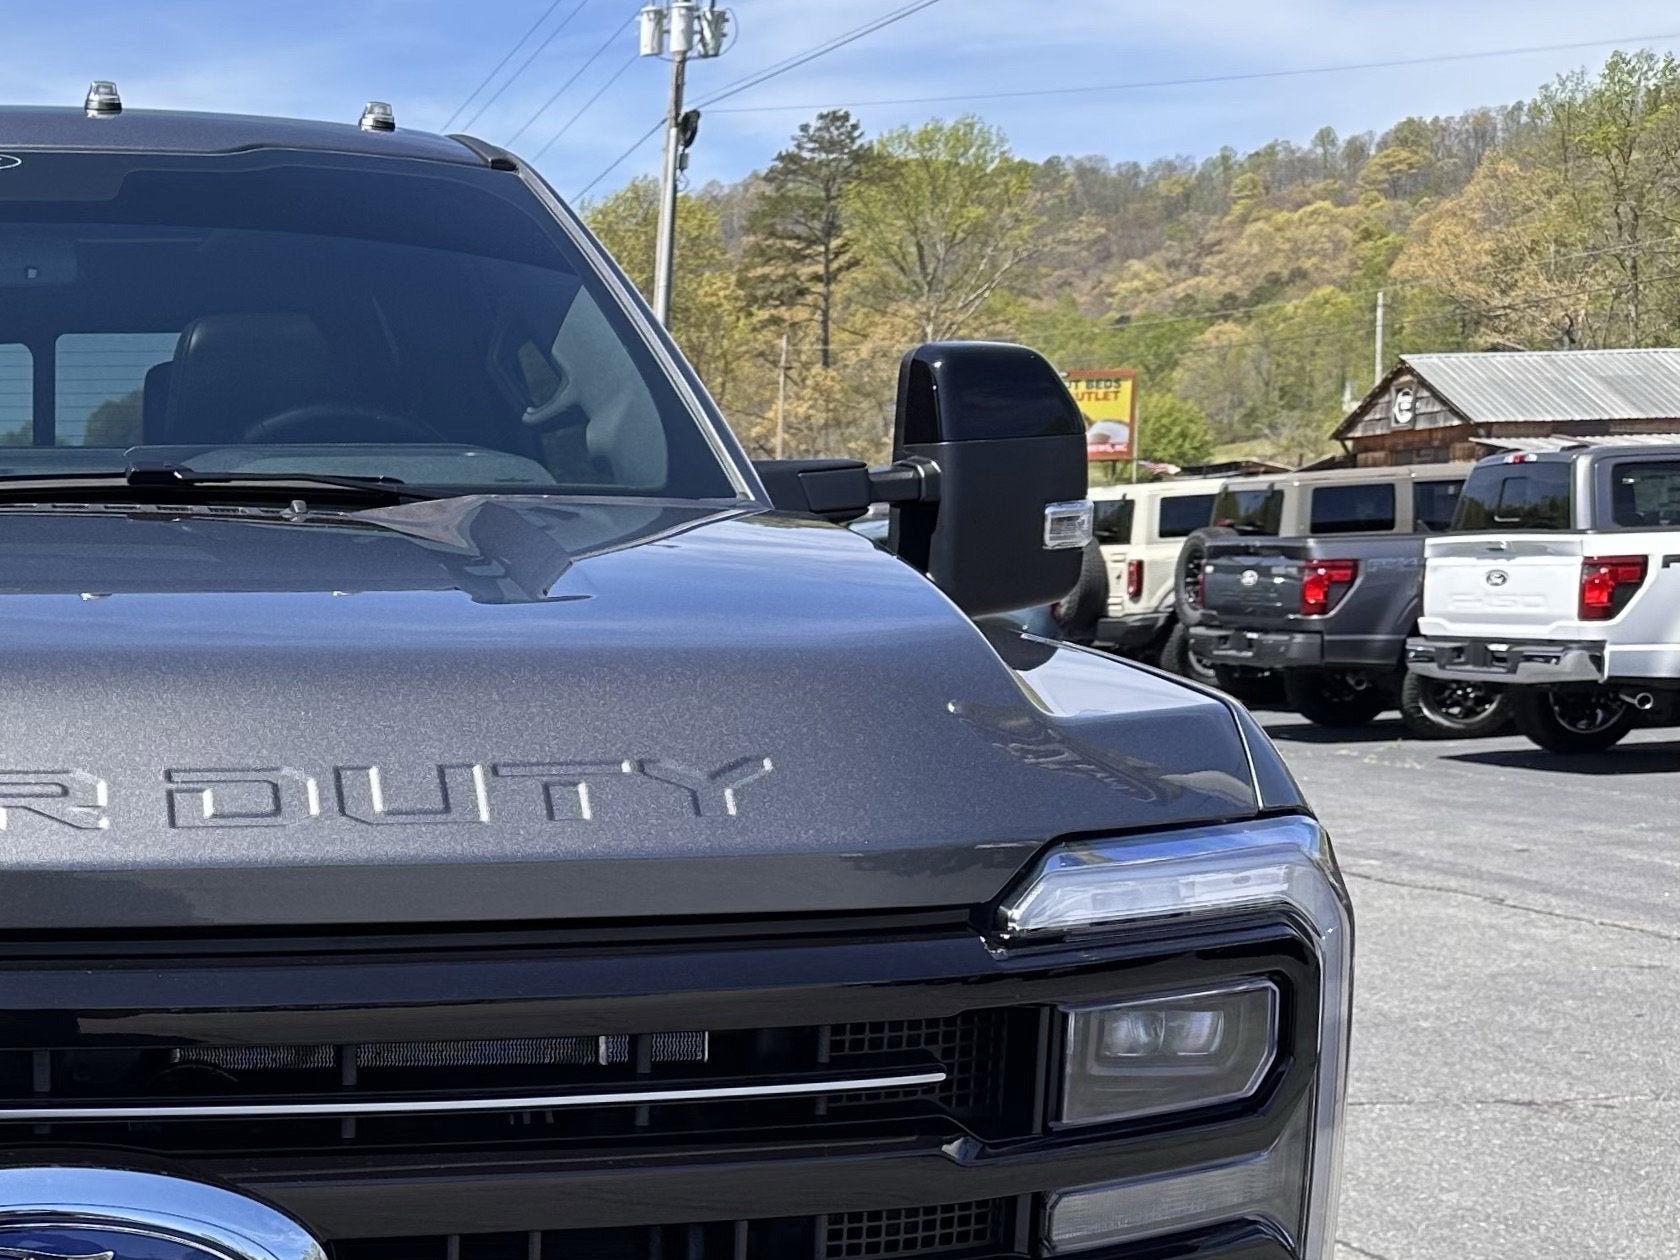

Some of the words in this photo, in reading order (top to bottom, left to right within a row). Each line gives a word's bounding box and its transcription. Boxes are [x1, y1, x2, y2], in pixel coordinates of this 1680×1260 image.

[1086, 378, 1121, 390] BEDS
[1076, 390, 1120, 402] UTLET
[164, 756, 774, 830] DUTY
